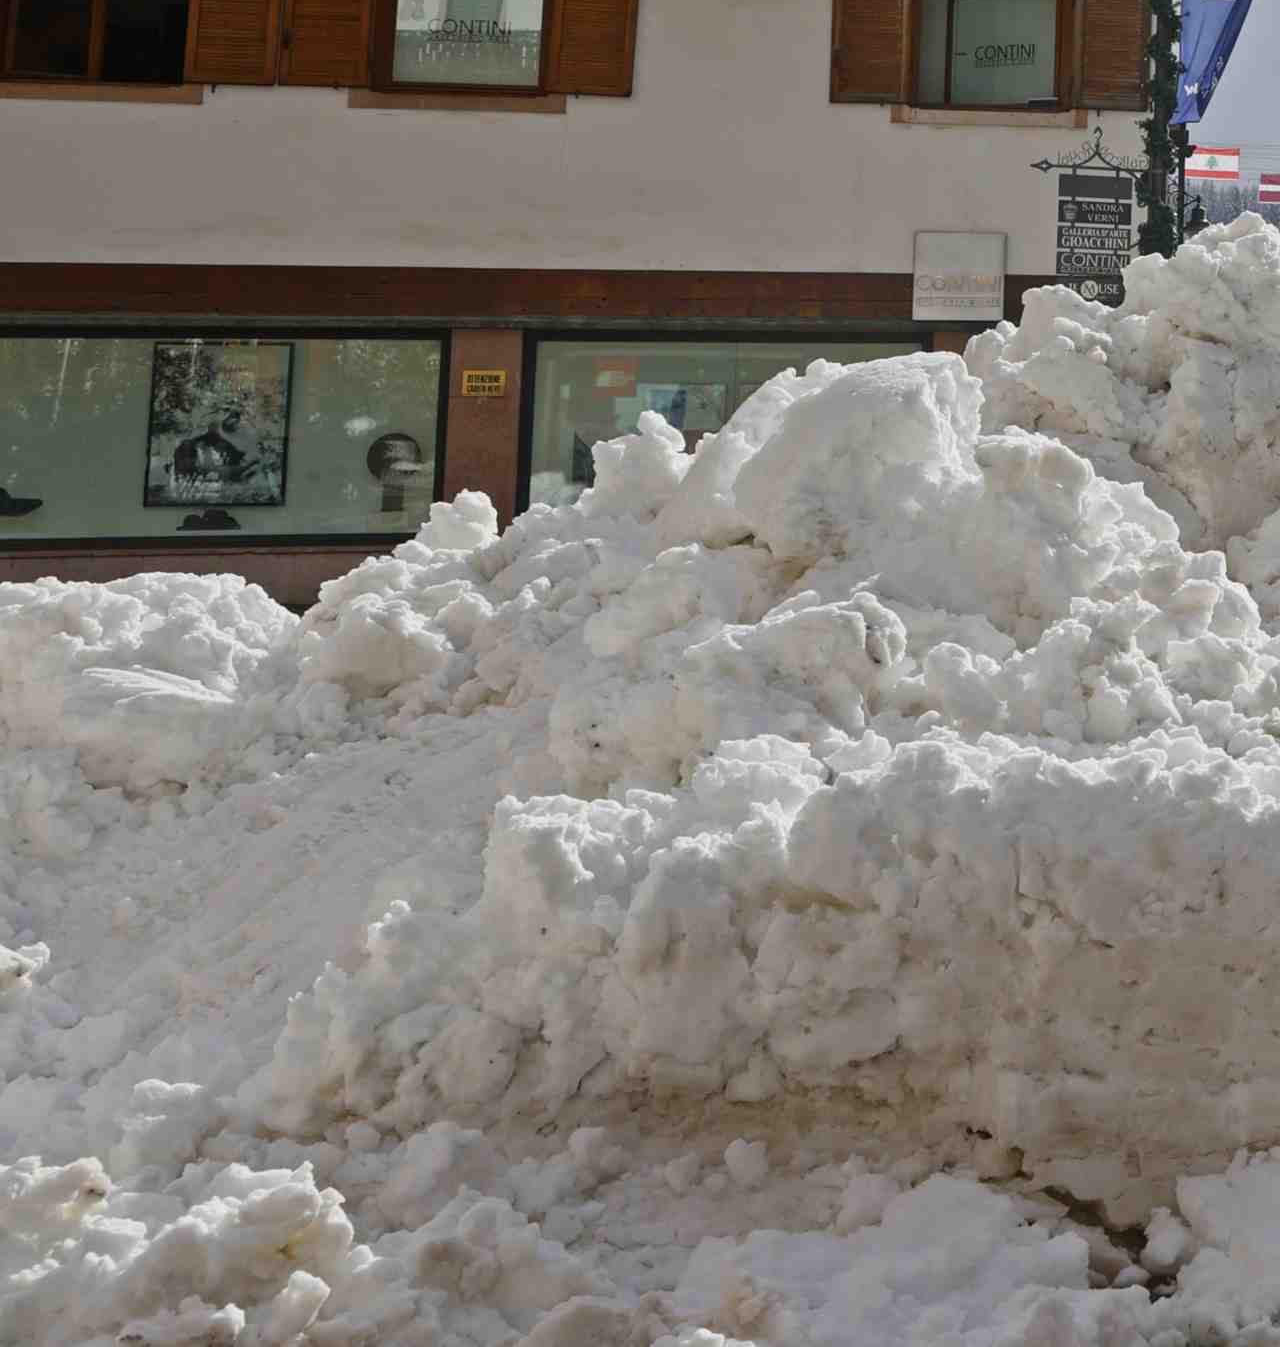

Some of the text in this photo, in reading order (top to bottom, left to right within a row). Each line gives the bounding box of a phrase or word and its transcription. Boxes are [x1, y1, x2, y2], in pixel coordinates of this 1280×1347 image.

[428, 18, 512, 36] CONTINI
[974, 43, 1035, 61] CONTINI
[1081, 203, 1124, 213] SANDRA
[1087, 213, 1119, 223] VERNI
[1062, 235, 1129, 249] GIOACCHINI
